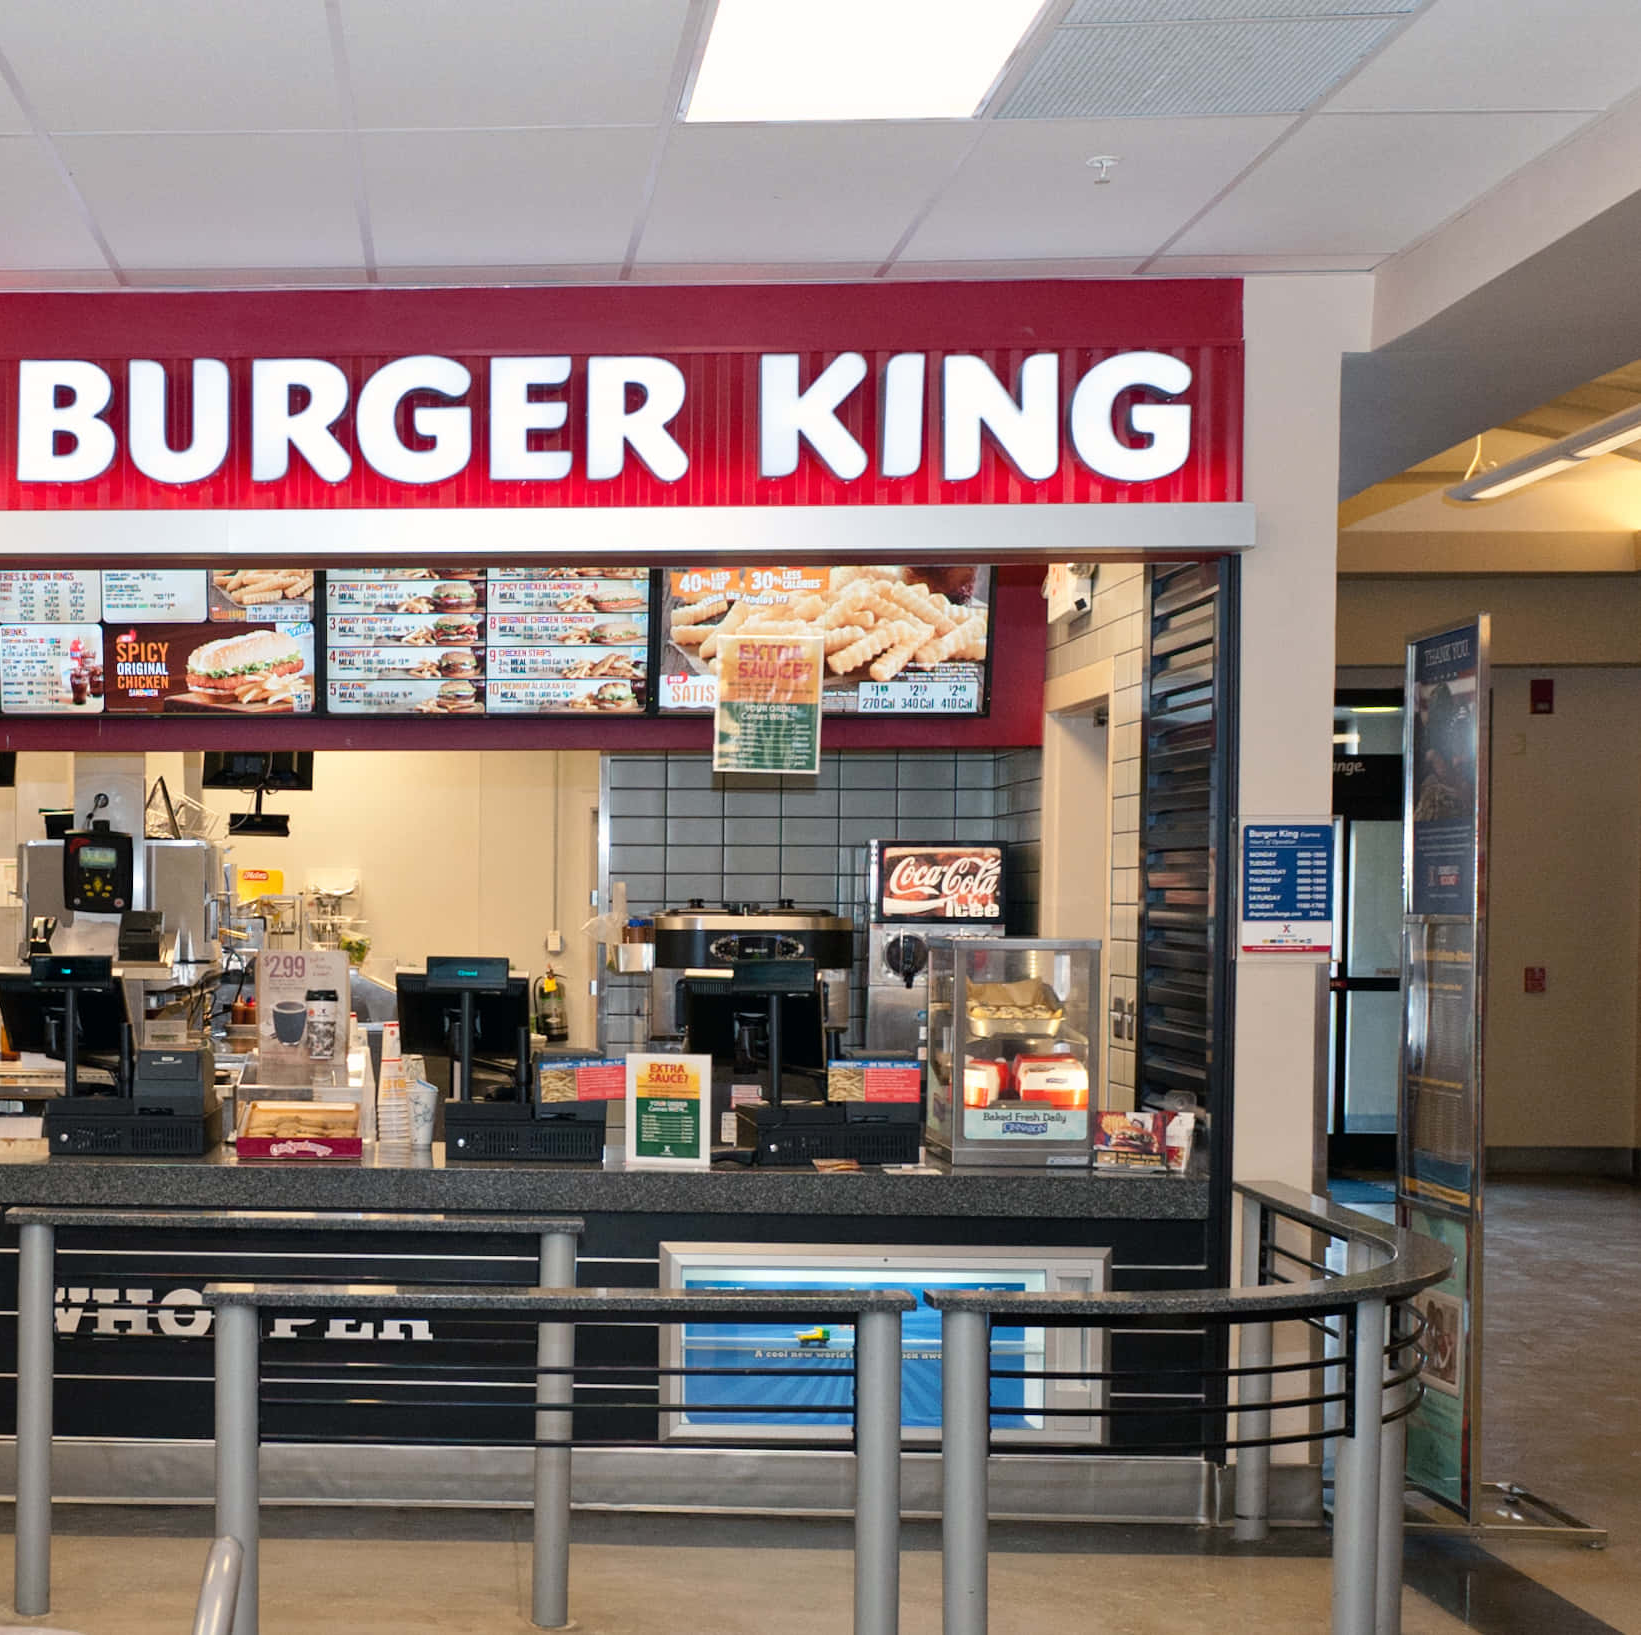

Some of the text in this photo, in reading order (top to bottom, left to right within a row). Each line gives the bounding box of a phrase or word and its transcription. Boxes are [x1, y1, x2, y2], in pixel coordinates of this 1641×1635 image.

[17, 350, 1192, 482] BURGER KING
[679, 573, 710, 593] 40%
[751, 571, 781, 590] 30%
[329, 584, 336, 597] 2
[490, 584, 496, 597] 7
[329, 617, 336, 630] 3
[116, 642, 169, 662] SPICY
[329, 650, 336, 663] 4
[490, 649, 496, 662] 9
[739, 644, 804, 660] EXTRA
[116, 662, 169, 675] ORIGINAL
[738, 661, 813, 680] SAUCE?
[117, 675, 169, 689] CHICKEN
[330, 682, 336, 695] 5
[863, 698, 972, 709] 270 Cal 340 Cal 410 Cal
[1279, 830, 1299, 839] King
[889, 856, 1001, 895] Coca-Cola
[650, 1064, 685, 1072] EXTRA
[648, 1074, 689, 1083] SAUCE?
[983, 1112, 1067, 1124] Baked Fresh Daily
